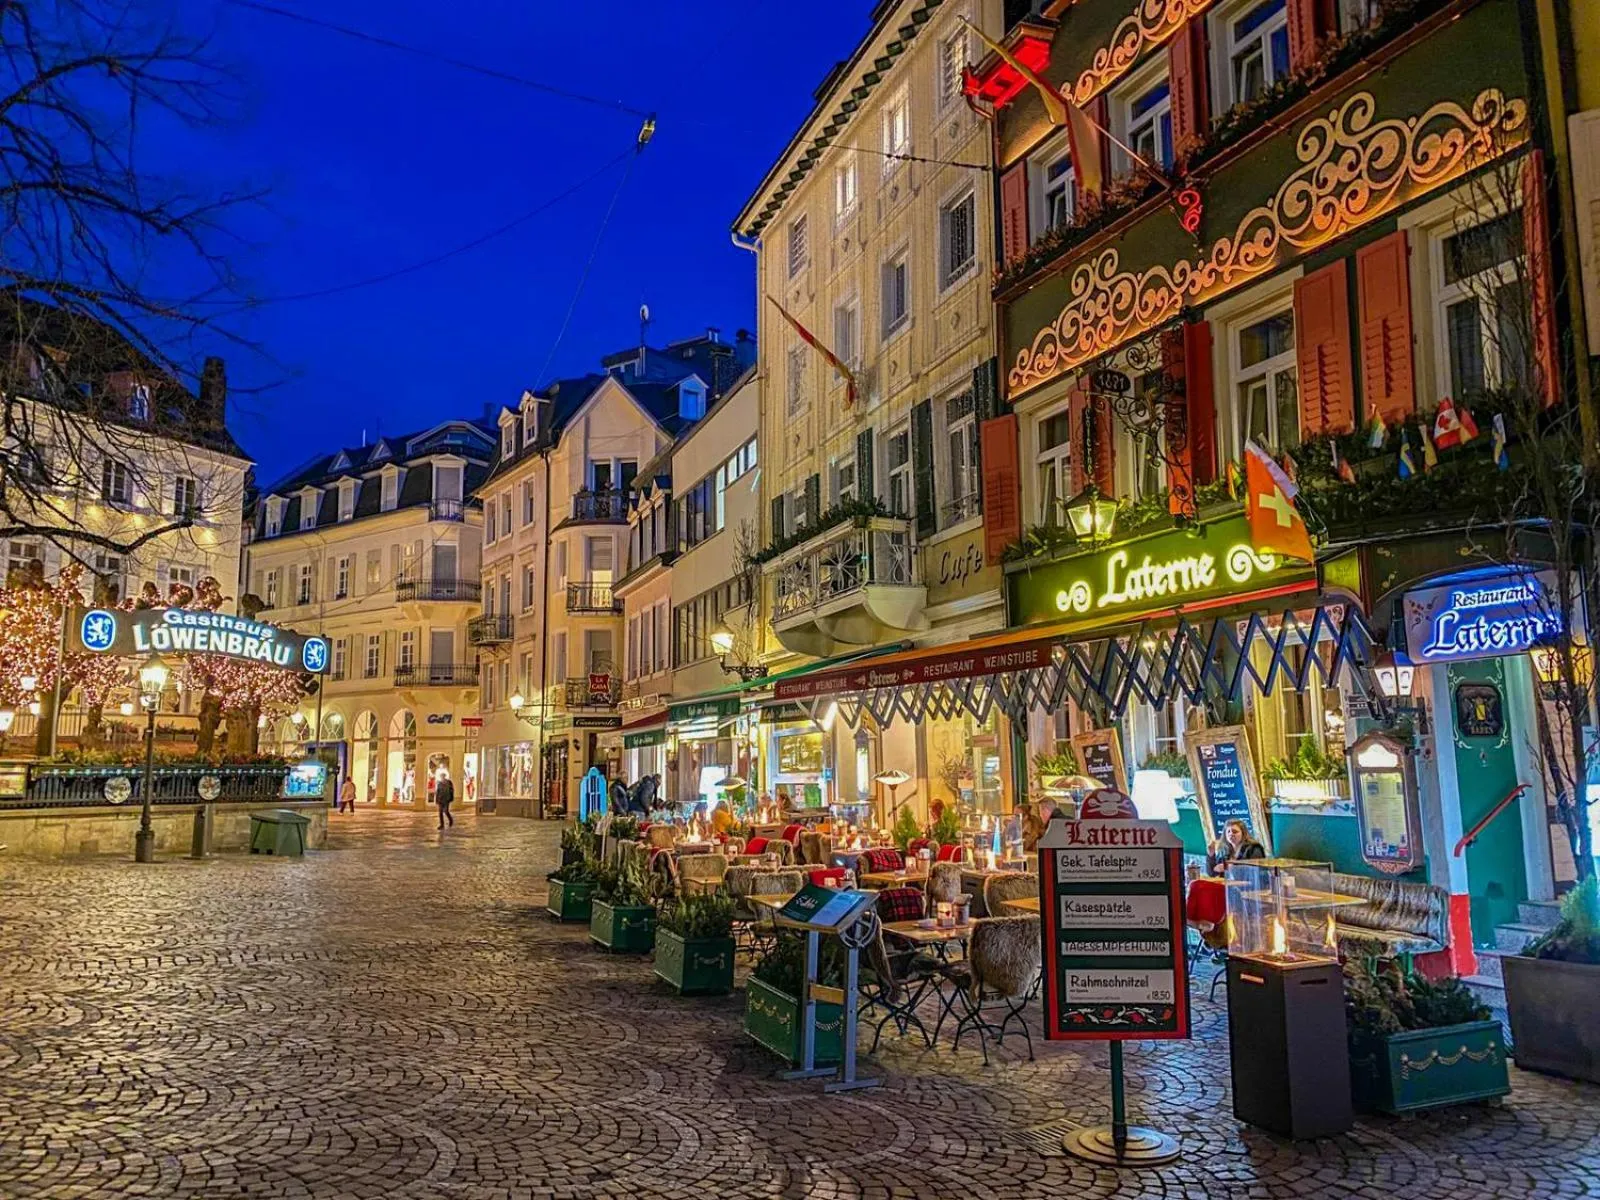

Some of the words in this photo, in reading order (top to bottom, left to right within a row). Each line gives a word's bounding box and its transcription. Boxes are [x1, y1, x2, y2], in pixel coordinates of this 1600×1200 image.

[1097, 550, 1216, 608] Laterne
[1452, 582, 1534, 610] Restaurant
[163, 611, 274, 639] Gasthaus
[132, 623, 290, 665] LÖWENBRÄU
[923, 659, 975, 677] RESTAURANT
[983, 650, 1038, 668] WEINSTUBE
[1207, 765, 1238, 779] Fondue
[1064, 821, 1158, 846] Laterne
[1087, 855, 1138, 872] Tafelspitz
[1064, 941, 1167, 952] TAGESEMPFEHLUNG
[1070, 975, 1150, 988] Rahmschnitzel
